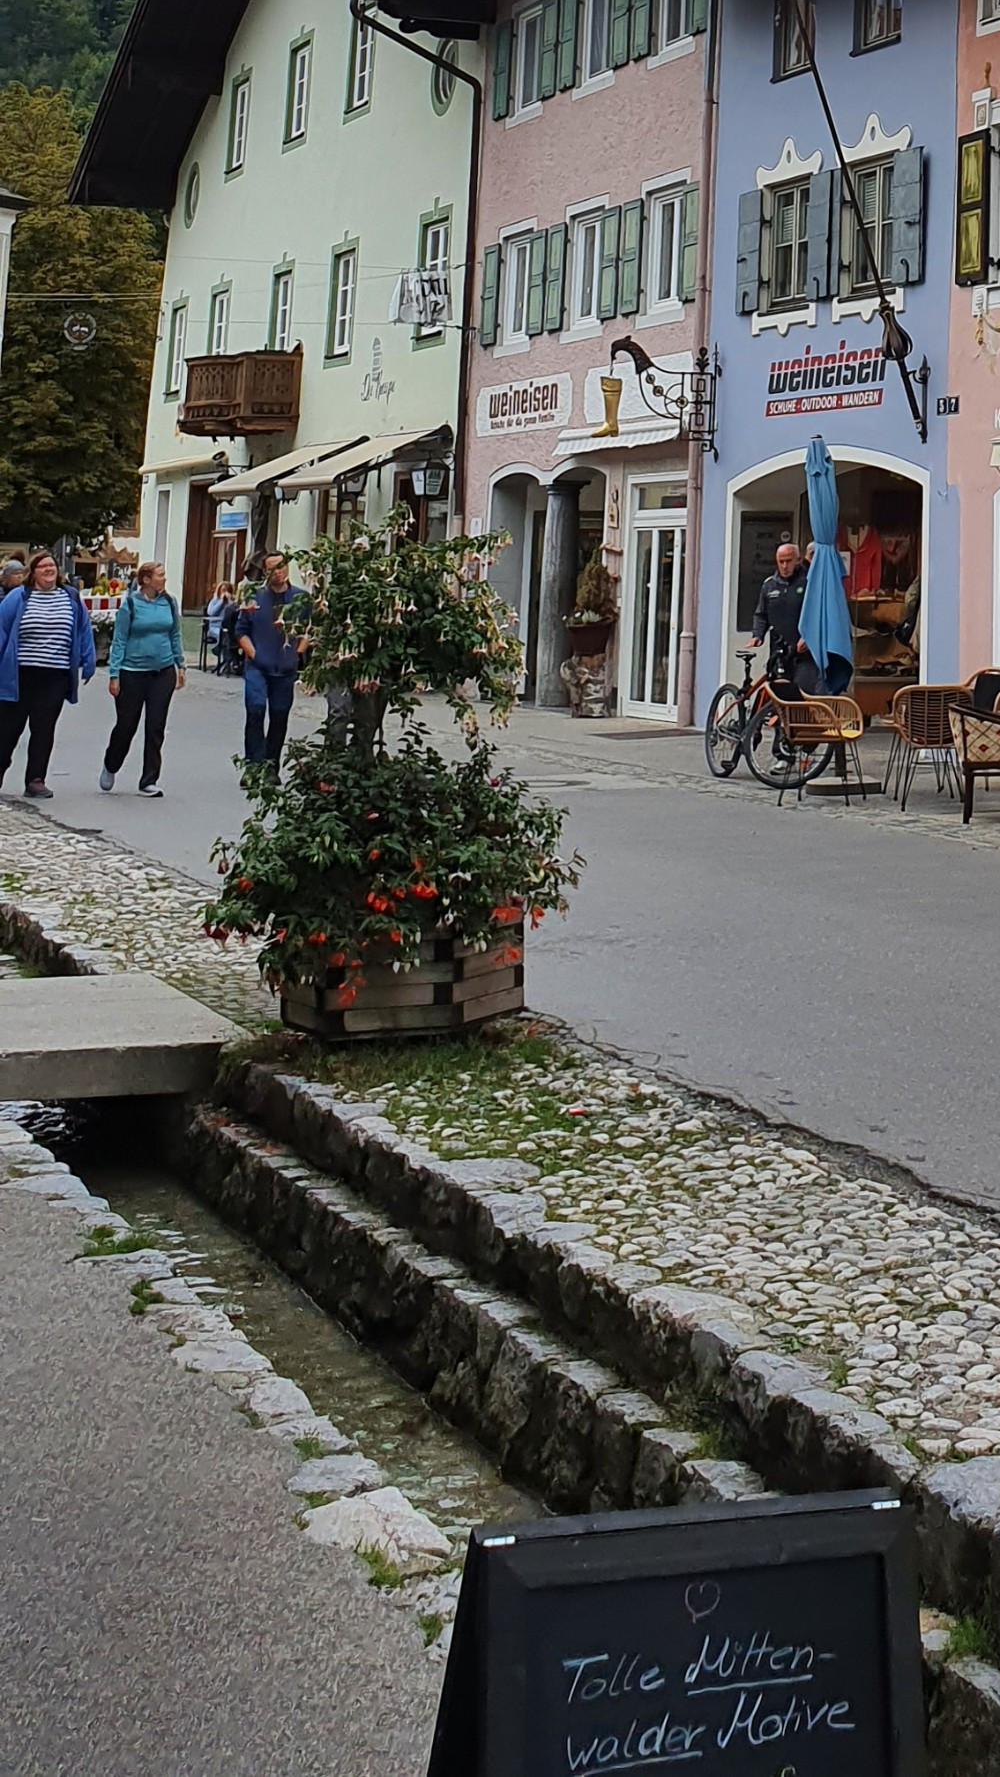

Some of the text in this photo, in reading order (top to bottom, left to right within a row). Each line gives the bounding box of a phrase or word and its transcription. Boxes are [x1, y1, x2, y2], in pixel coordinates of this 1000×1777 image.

[767, 339, 888, 395] weineisen
[489, 381, 559, 419] weineisen
[768, 390, 880, 415] SCHUHE OUTDOOR WANDERN
[562, 1630, 836, 1704] Tolle Mitten-
[717, 1691, 856, 1750] Motive
